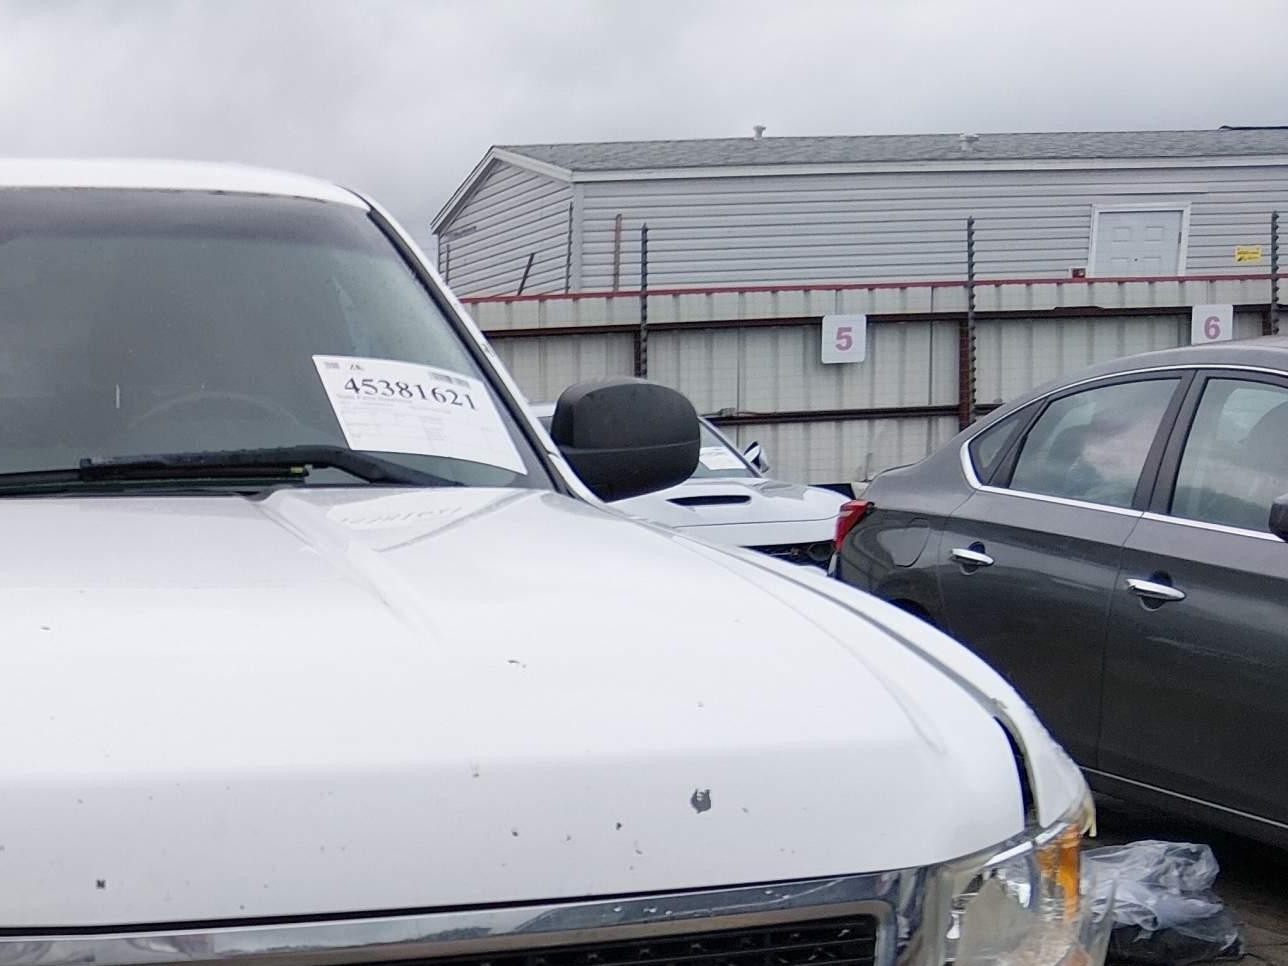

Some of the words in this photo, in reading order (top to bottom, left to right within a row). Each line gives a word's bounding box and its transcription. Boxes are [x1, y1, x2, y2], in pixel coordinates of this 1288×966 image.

[835, 326, 854, 352] 5
[1203, 316, 1221, 340] 6
[343, 376, 479, 411] 45381621
